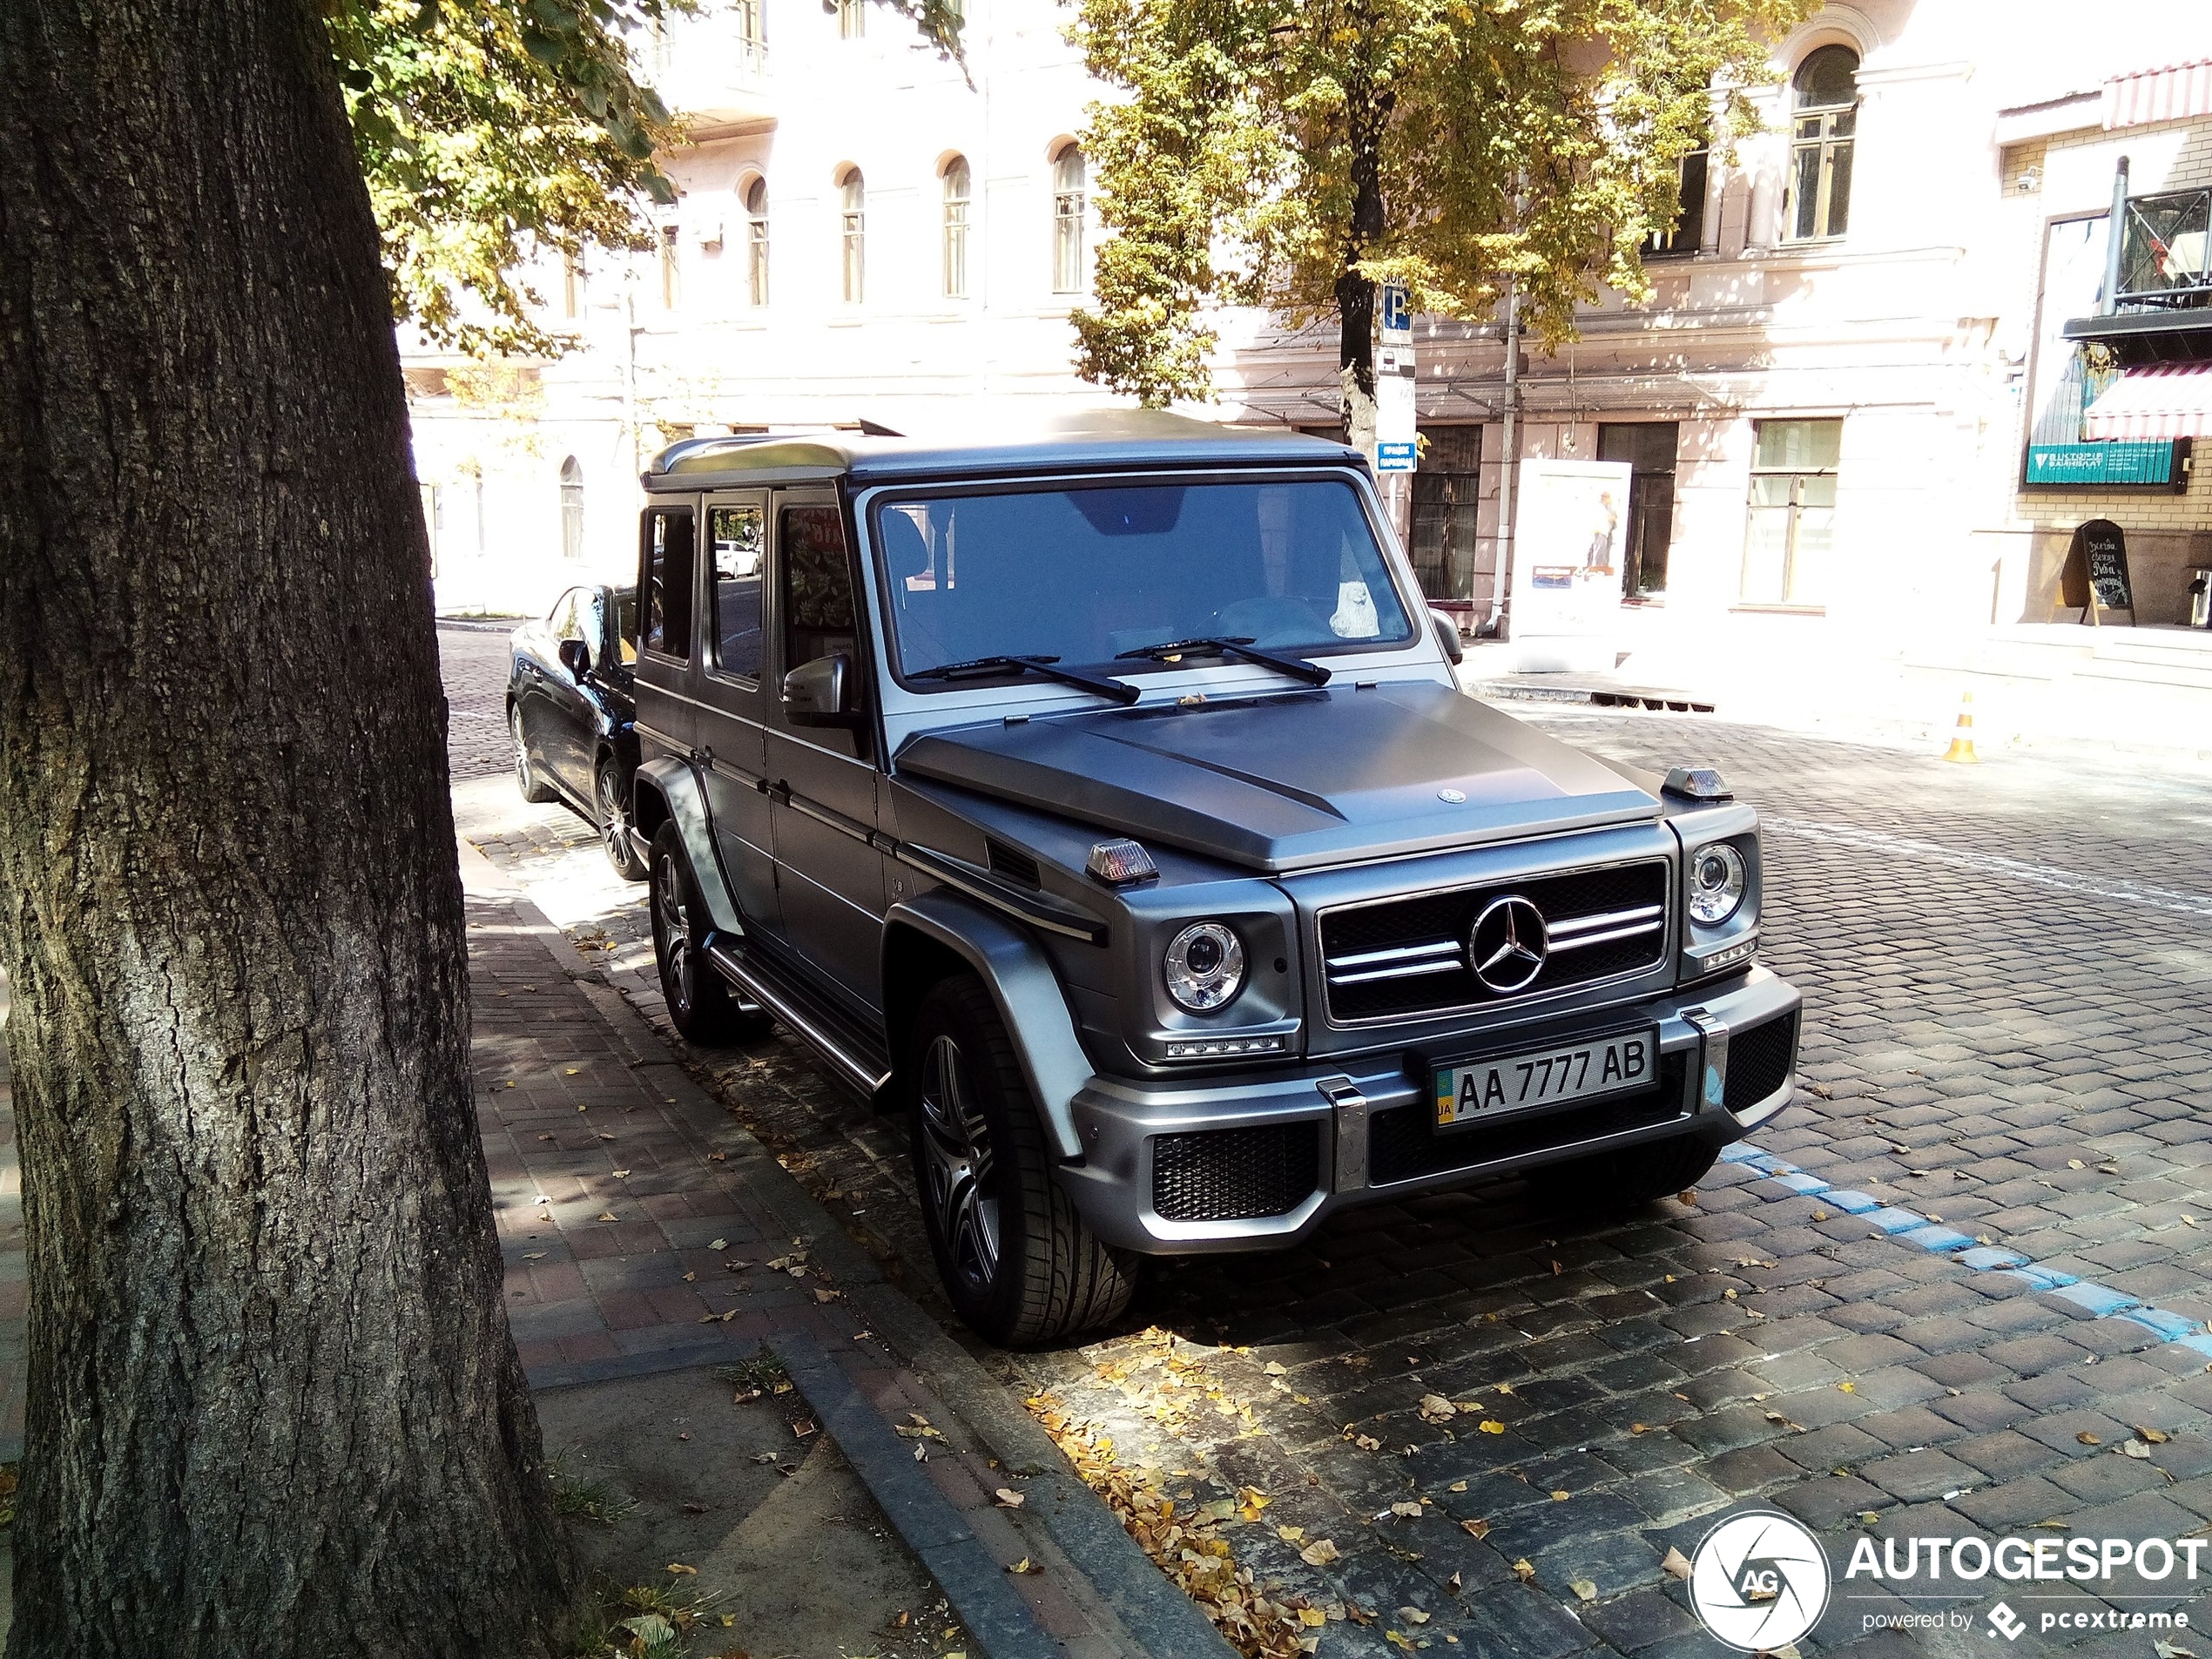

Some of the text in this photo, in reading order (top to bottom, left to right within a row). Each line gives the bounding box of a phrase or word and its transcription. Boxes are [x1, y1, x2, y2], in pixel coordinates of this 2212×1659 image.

[1458, 1040, 1646, 1113] AA 7777 AB
[1438, 1105, 1451, 1116] UA
